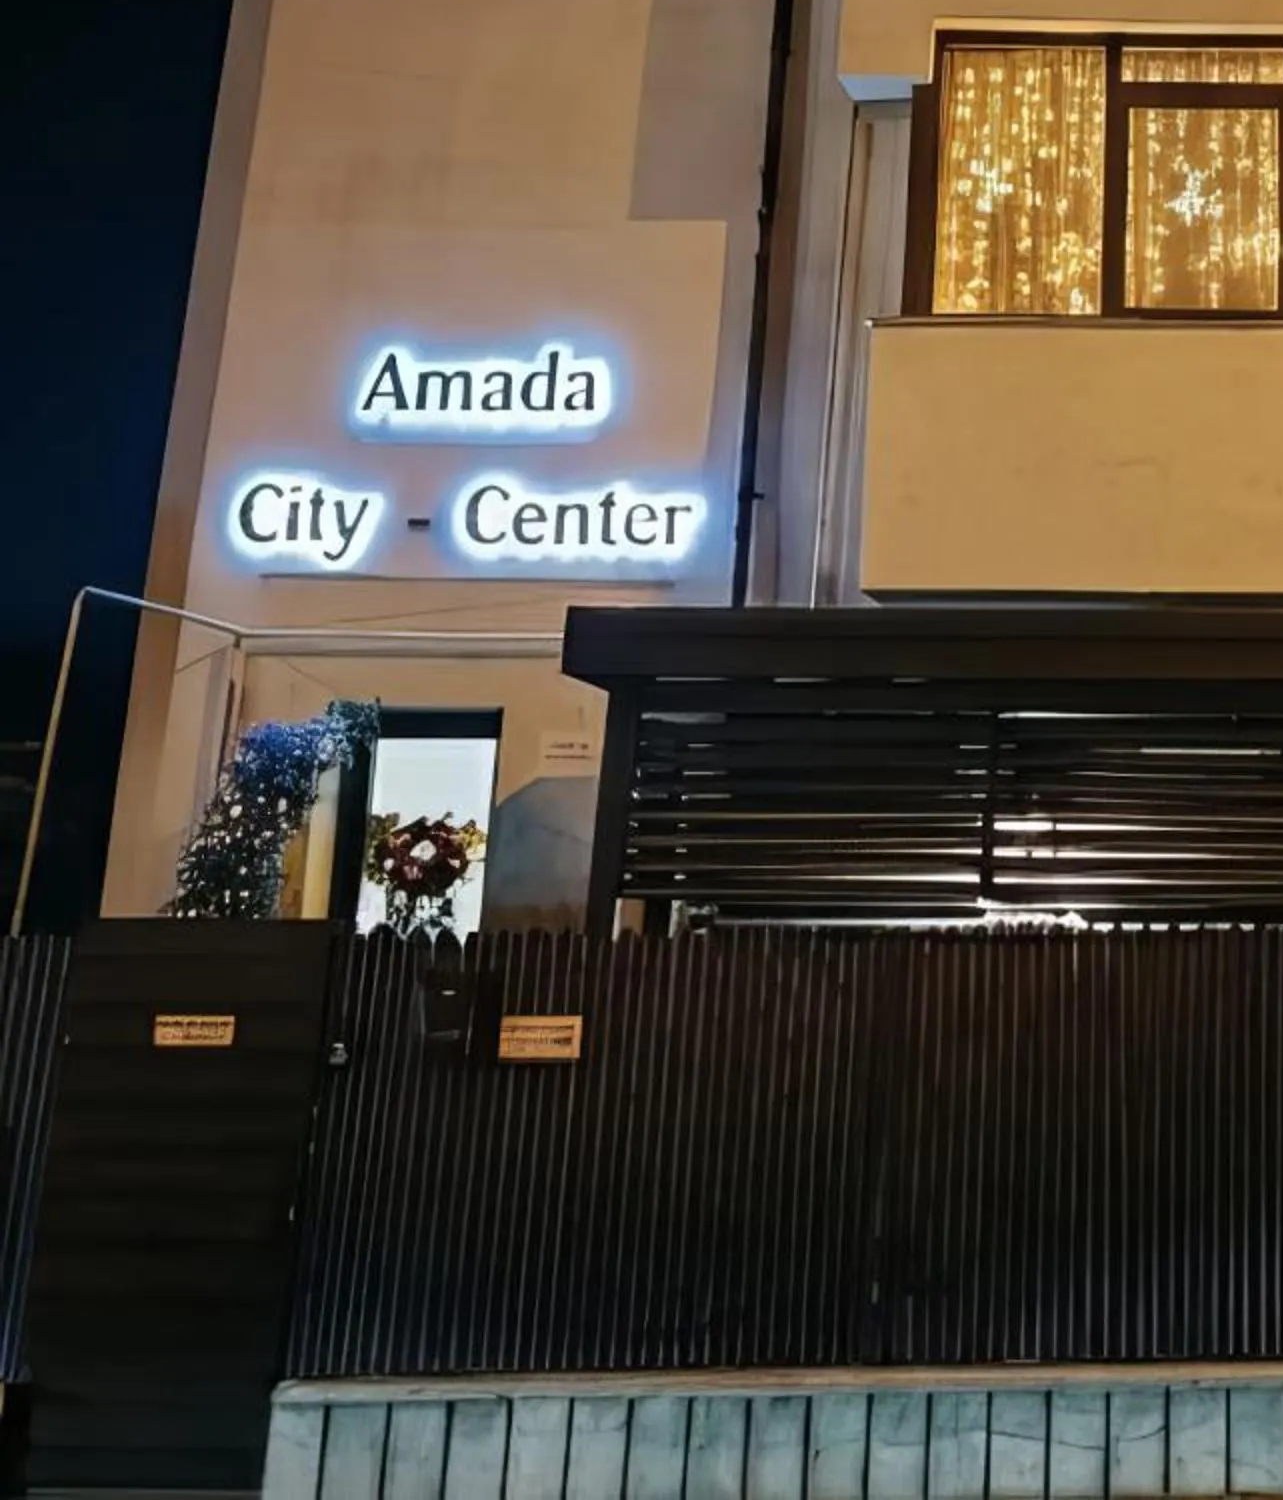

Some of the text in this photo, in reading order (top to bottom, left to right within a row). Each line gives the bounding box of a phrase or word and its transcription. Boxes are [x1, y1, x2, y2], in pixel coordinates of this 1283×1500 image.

[361, 351, 596, 411] Amada
[238, 482, 369, 562] City
[463, 485, 693, 546] Center
